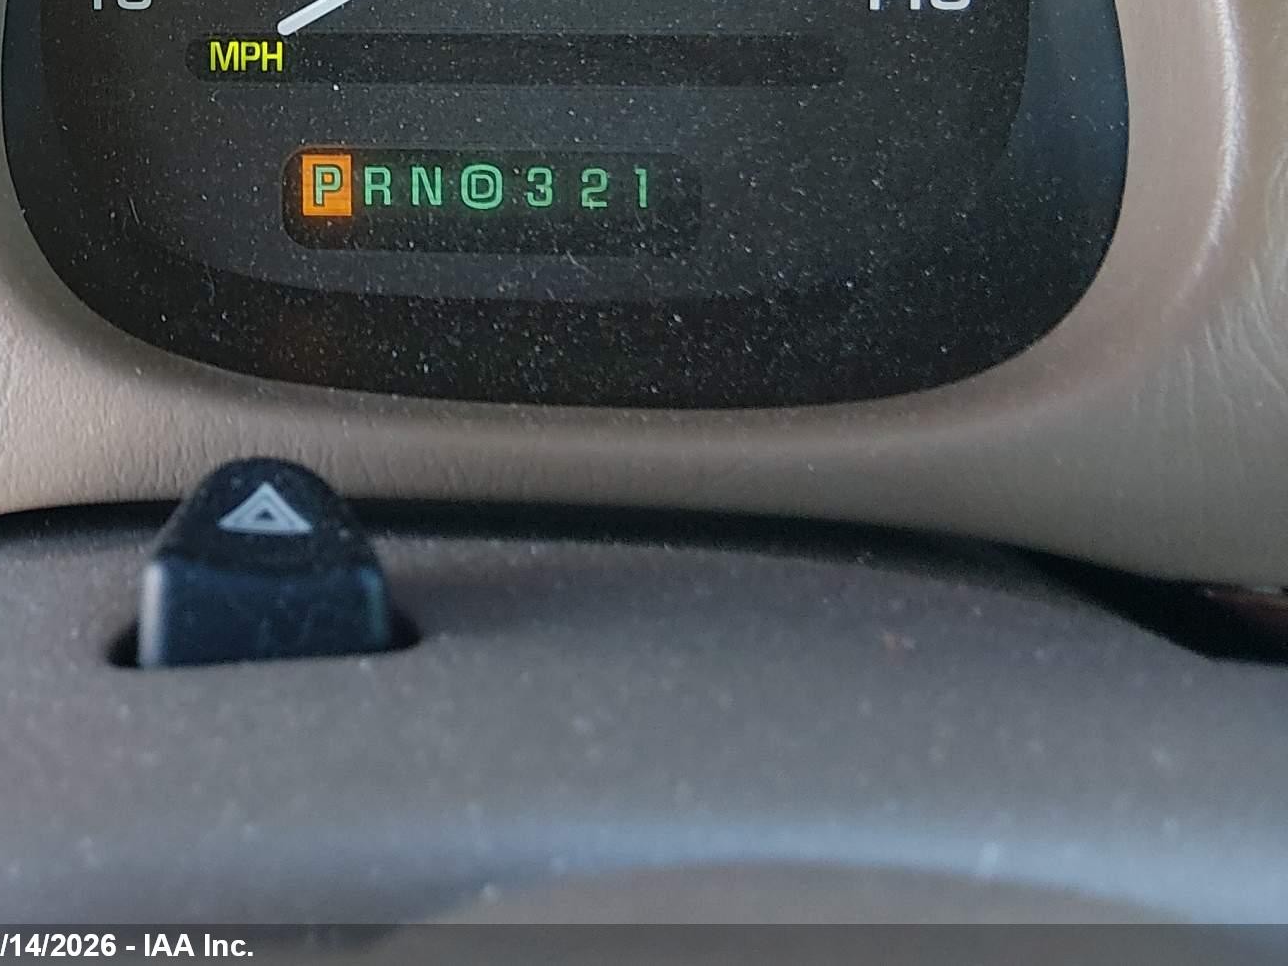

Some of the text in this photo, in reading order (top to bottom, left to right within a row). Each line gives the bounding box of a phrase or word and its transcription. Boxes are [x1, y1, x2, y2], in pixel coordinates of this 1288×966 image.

[210, 40, 283, 72] MPH
[313, 166, 341, 206] P
[364, 167, 392, 206] R
[411, 167, 442, 206] N
[526, 167, 554, 207] 3
[580, 167, 609, 208] 2
[634, 168, 649, 208] 1
